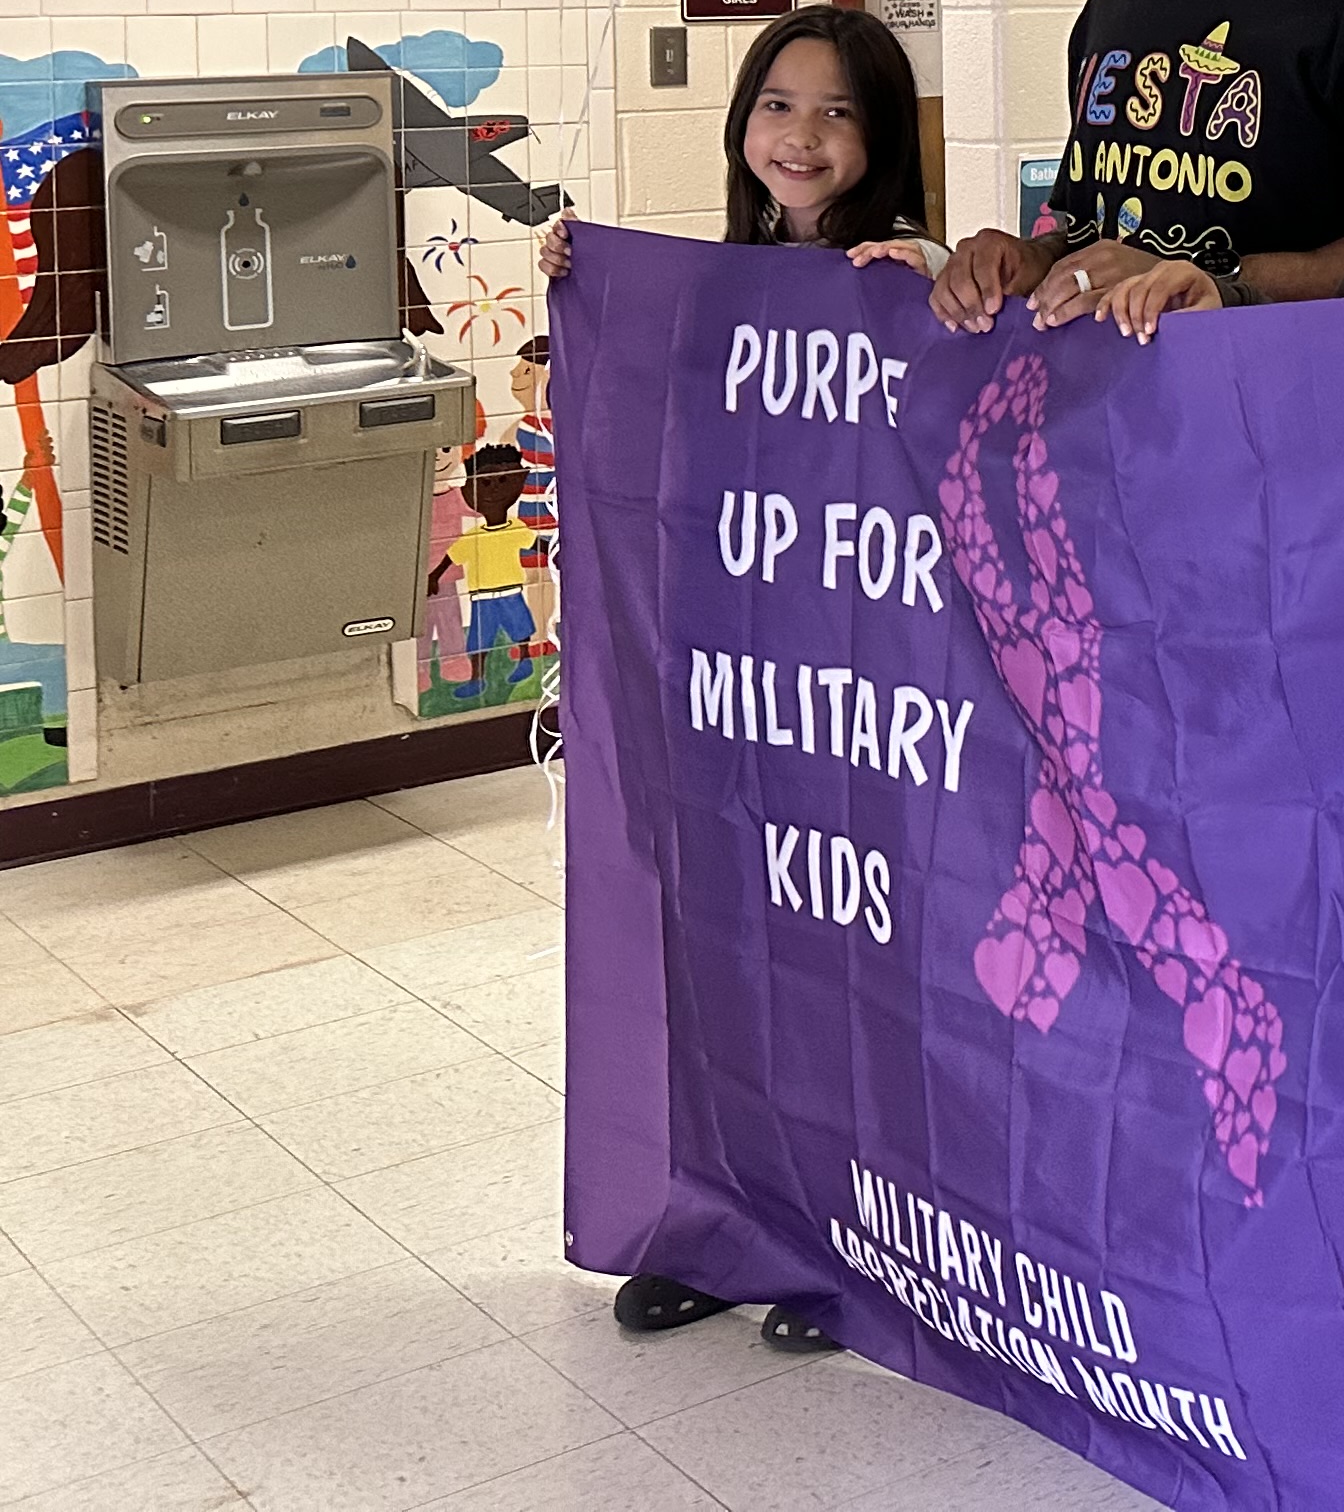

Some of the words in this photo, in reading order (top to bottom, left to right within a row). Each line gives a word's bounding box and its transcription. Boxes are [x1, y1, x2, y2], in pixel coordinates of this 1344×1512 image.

[895, 7, 925, 18] WASH
[226, 110, 278, 120] ELKAY
[1095, 141, 1252, 203] ANTONIO
[300, 254, 346, 264] ELKAY
[718, 490, 798, 584] UP
[822, 502, 944, 614] FOR
[348, 622, 391, 633] ELKAY
[690, 648, 975, 793] MILITARY
[765, 822, 892, 945] KIDS
[851, 1159, 1006, 1308] MILITARY
[1015, 1252, 1138, 1364] CHILD
[830, 1218, 1078, 1400] APPRECIATION
[1072, 1356, 1247, 1461] MONTH
